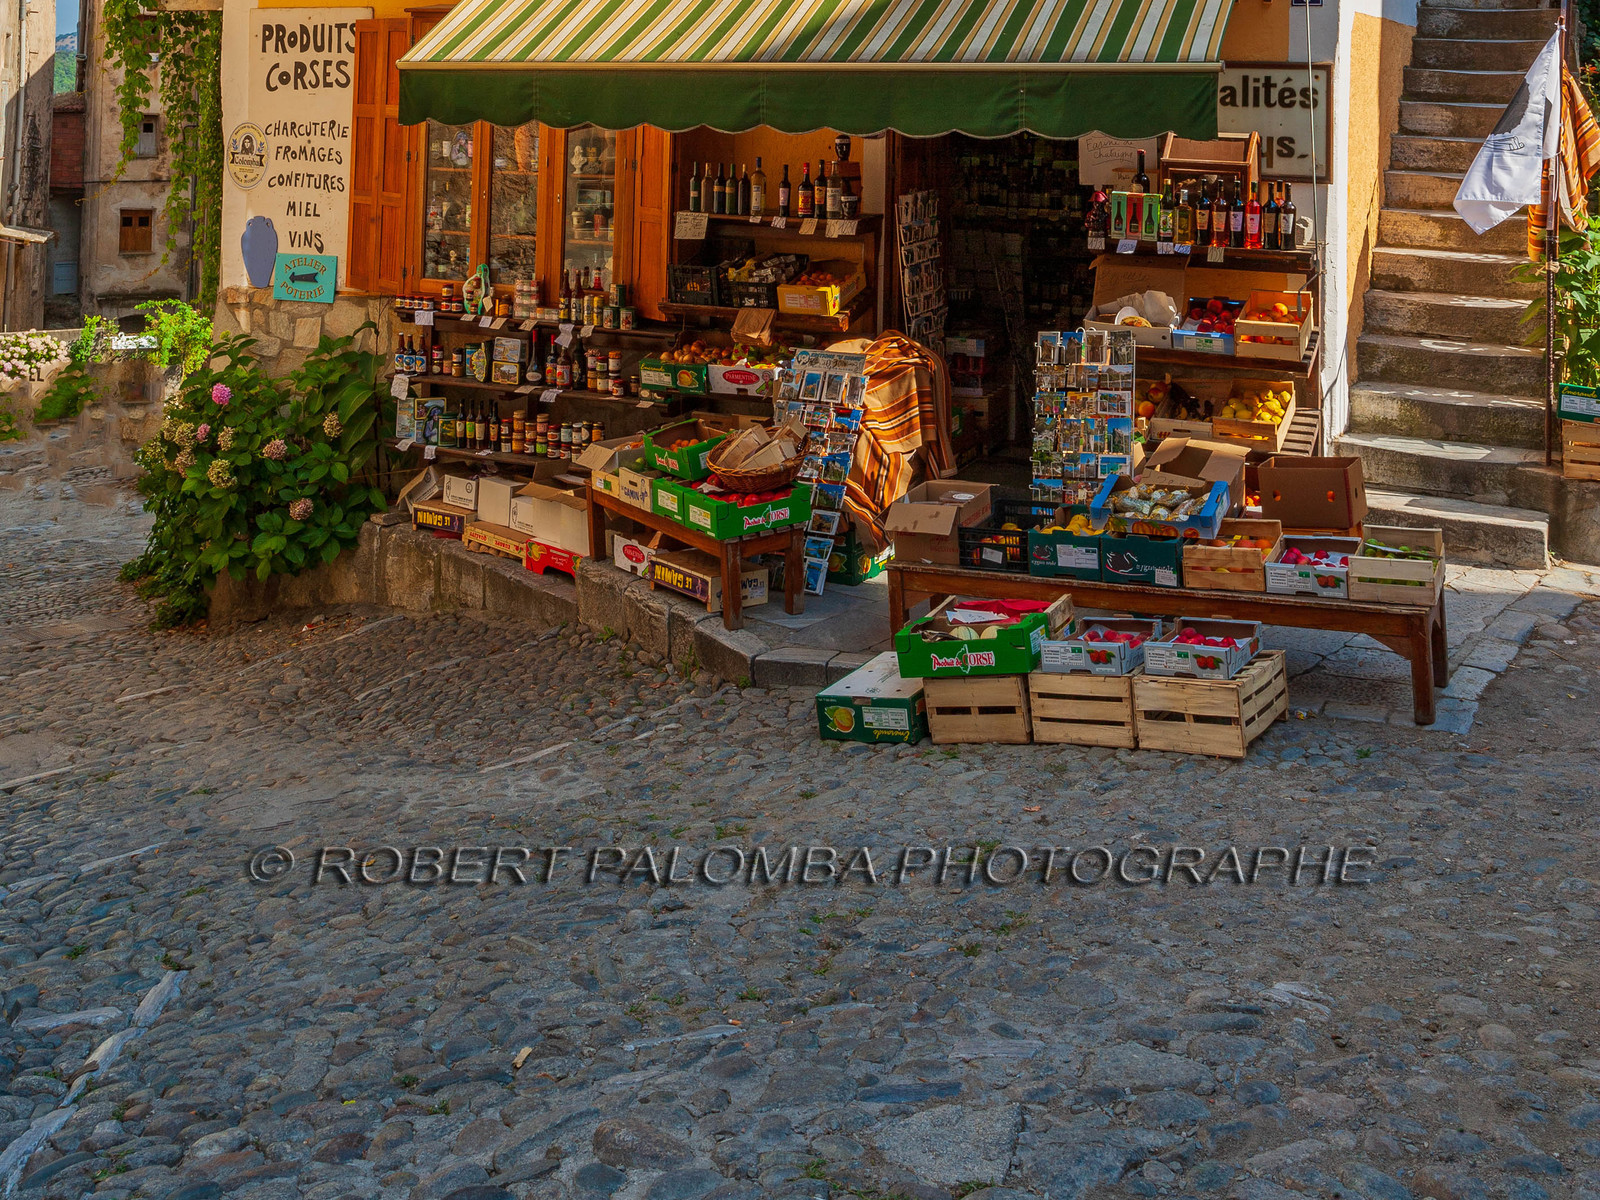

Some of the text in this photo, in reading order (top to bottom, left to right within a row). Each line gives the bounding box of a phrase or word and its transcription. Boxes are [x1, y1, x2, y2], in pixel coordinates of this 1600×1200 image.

[261, 22, 355, 54] PRODUITS
[265, 60, 350, 92] CORSES
[1219, 75, 1319, 109] alités
[264, 119, 349, 140] CHARCUTERIE
[275, 145, 343, 165] FROMAGES
[268, 170, 345, 193] CONFITURES
[286, 200, 320, 217] MIEL
[288, 229, 324, 254] VINS
[284, 257, 327, 275] ATELIER
[280, 280, 325, 300] POTERIE
[417, 511, 443, 527] GAMIN
[654, 564, 684, 589] GAMIN
[963, 652, 994, 666] CORSE
